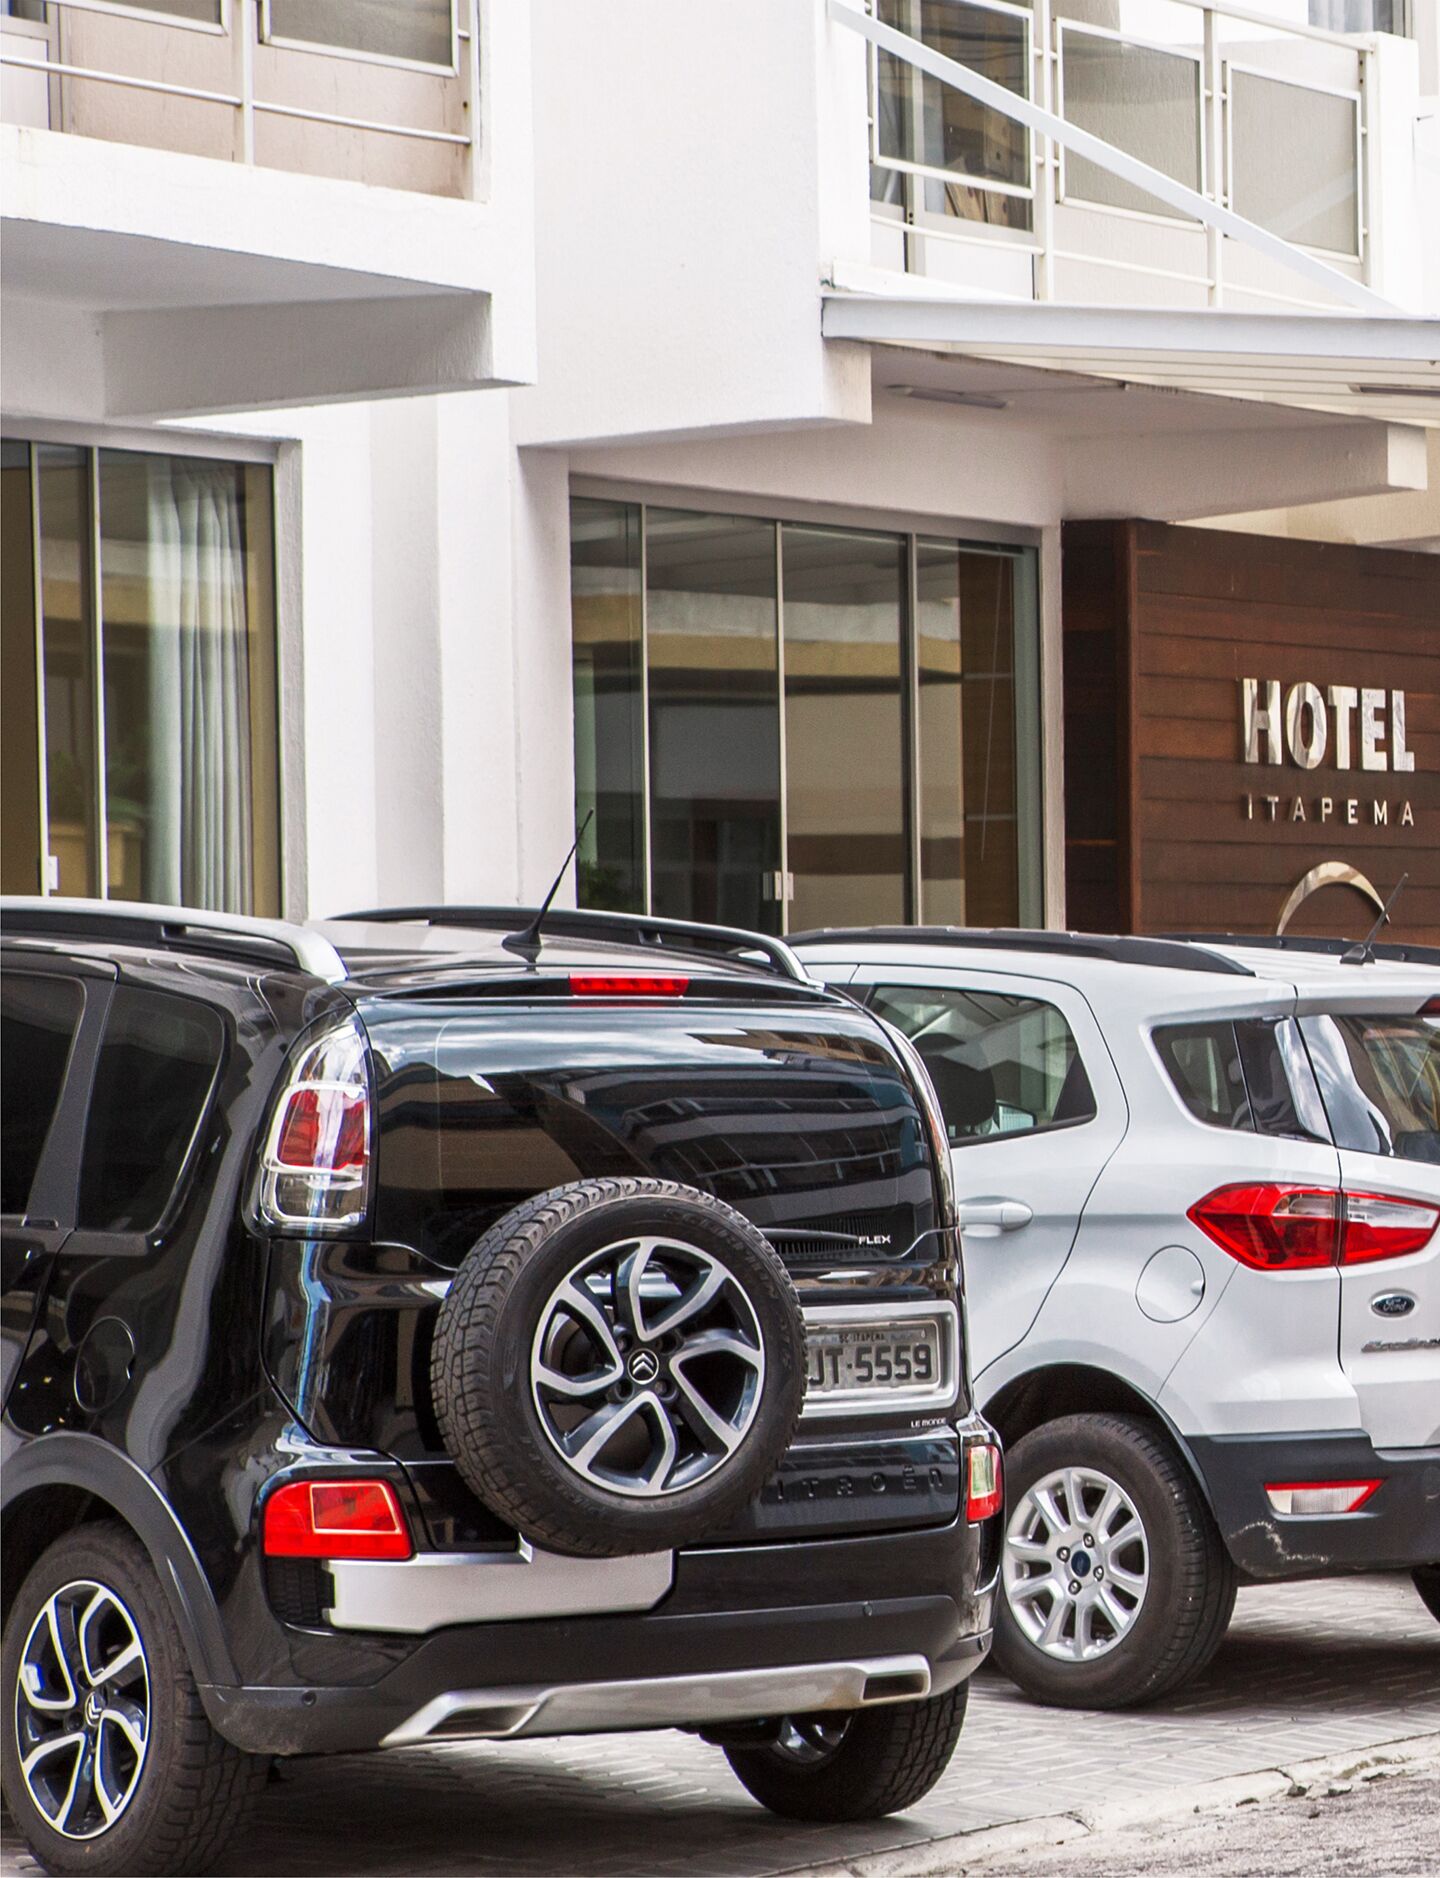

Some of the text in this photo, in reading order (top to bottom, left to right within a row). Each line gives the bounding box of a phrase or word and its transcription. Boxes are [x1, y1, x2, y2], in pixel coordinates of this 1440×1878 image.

[1243, 677, 1415, 772] HOTEL
[1247, 793, 1414, 826] ITAPEMA
[859, 1234, 891, 1245] FLEX
